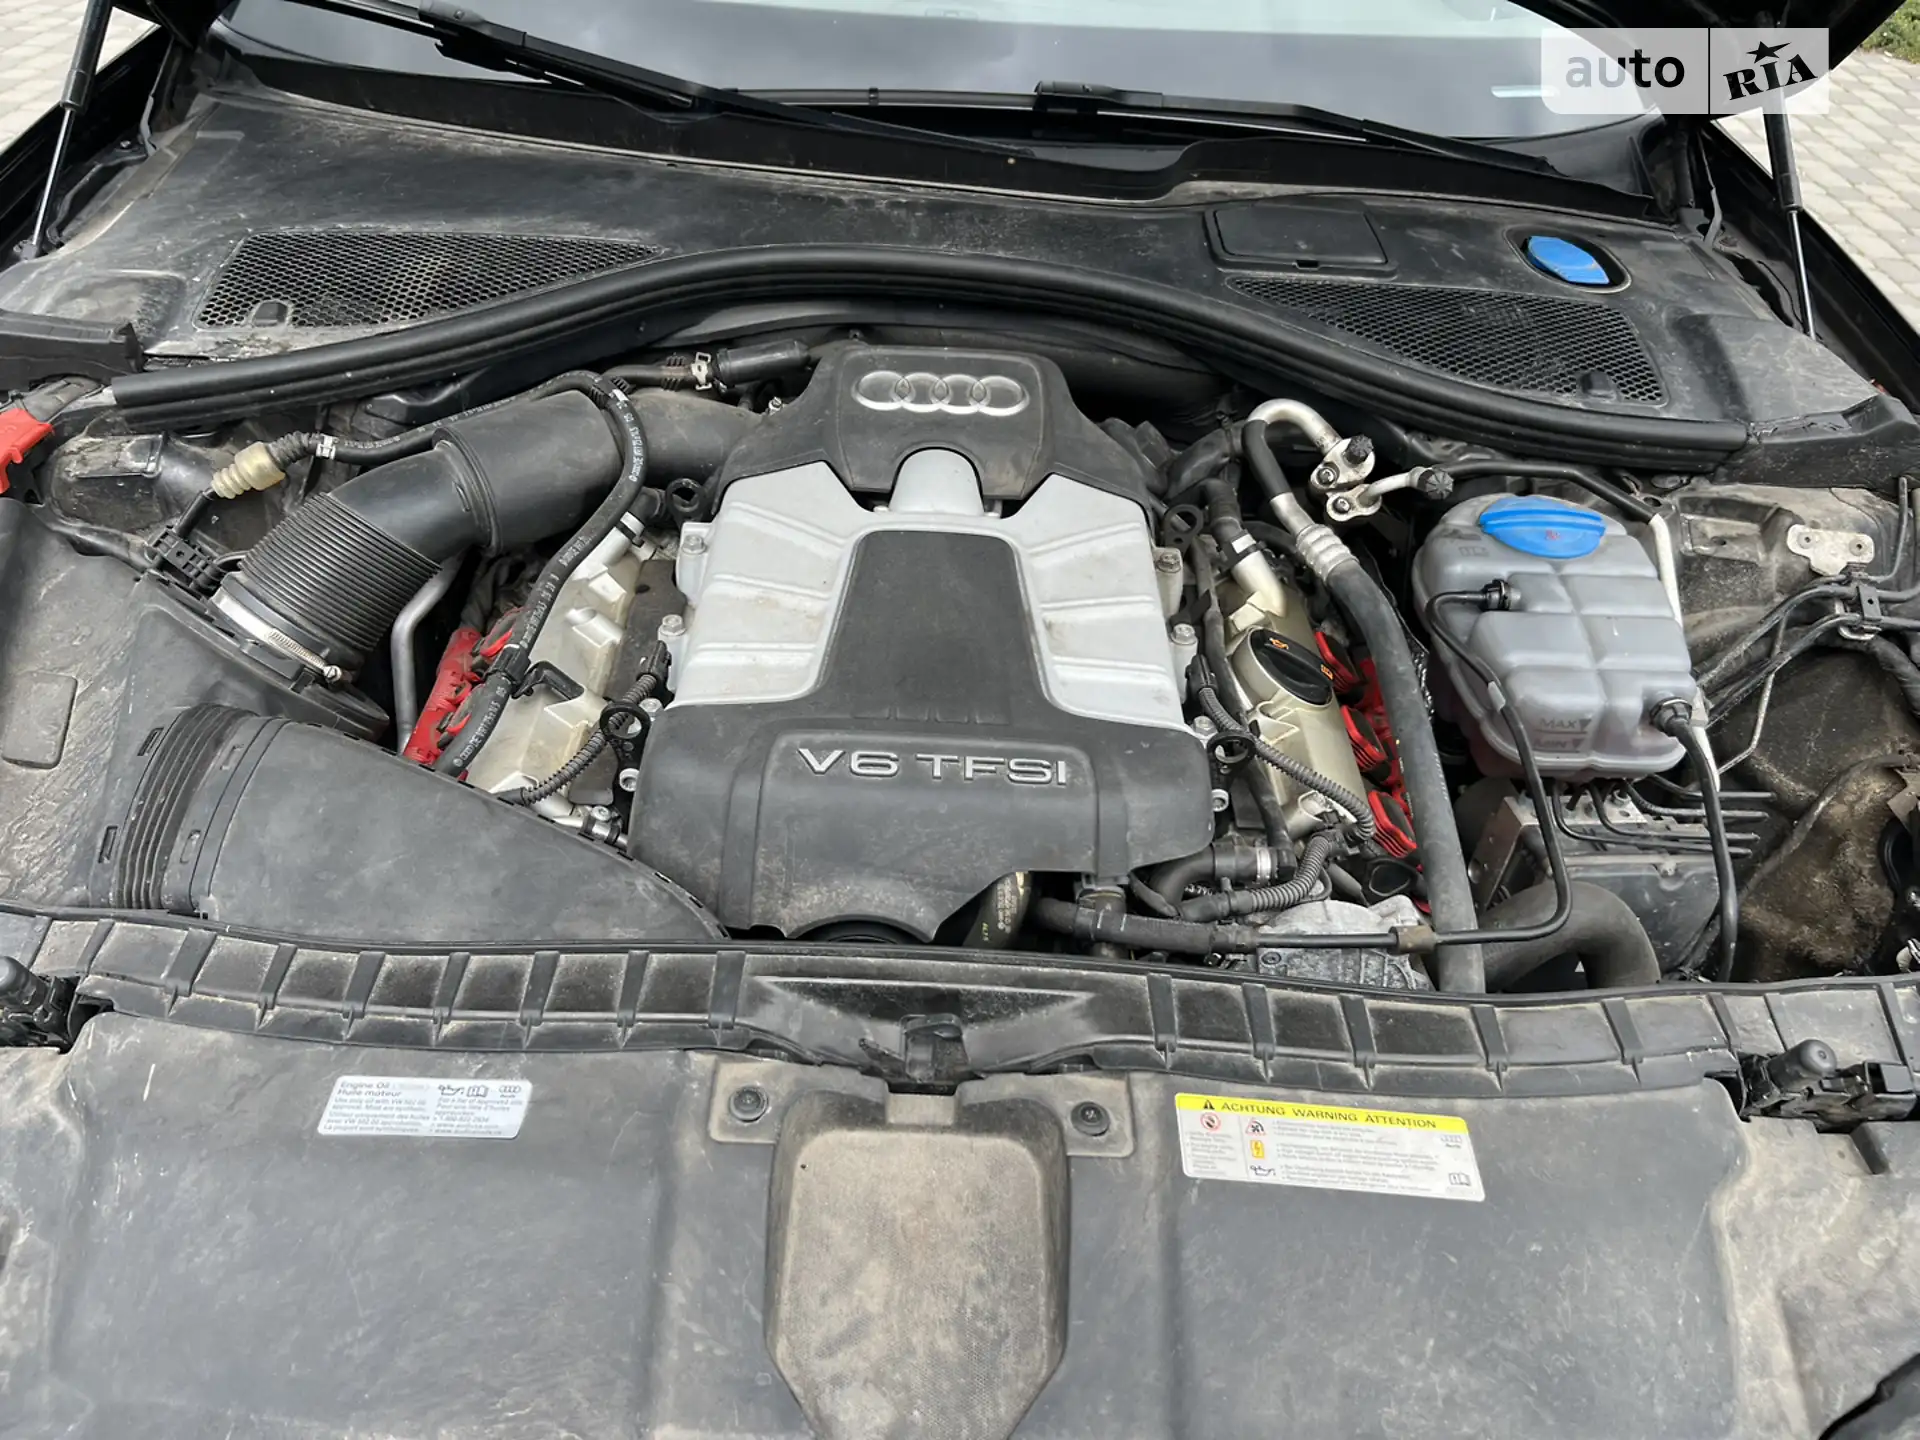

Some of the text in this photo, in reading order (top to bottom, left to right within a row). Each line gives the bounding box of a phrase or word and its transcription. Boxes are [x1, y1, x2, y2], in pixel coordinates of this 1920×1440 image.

[1540, 717, 1577, 729] MAX
[797, 748, 1067, 785] V6 TFSI
[340, 1080, 374, 1090] Engine
[376, 1081, 390, 1089] Oil
[1221, 1102, 1286, 1116] ACHTUNG
[1292, 1108, 1358, 1122] WARNING
[1364, 1114, 1437, 1129] ATTENTION
